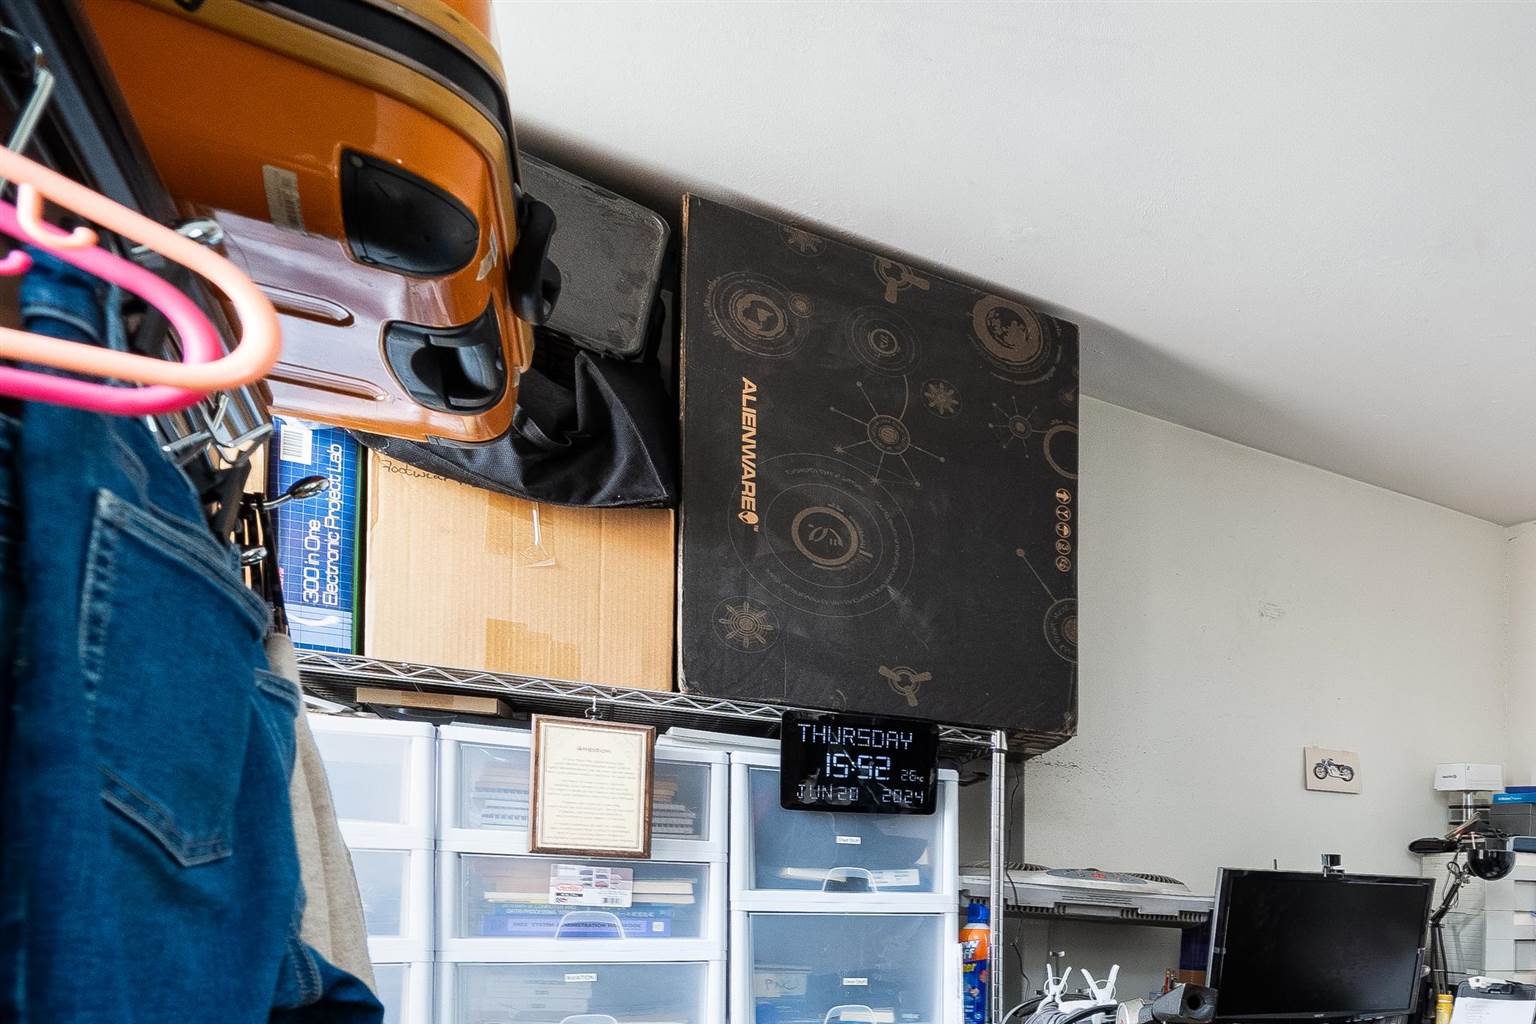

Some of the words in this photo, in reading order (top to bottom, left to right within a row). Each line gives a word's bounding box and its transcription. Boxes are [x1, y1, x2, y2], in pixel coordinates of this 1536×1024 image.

[327, 443, 343, 474] Lab
[741, 376, 758, 512] ALIENWARE
[324, 475, 343, 529] Project
[304, 519, 321, 550] One
[304, 550, 319, 564] in
[323, 530, 340, 606] Electronic
[303, 567, 320, 604] 300
[797, 723, 914, 750] THURSDAY
[825, 752, 891, 781] 15:52
[796, 784, 833, 800] JUN
[837, 786, 859, 801] 20
[881, 788, 924, 804] 2024
